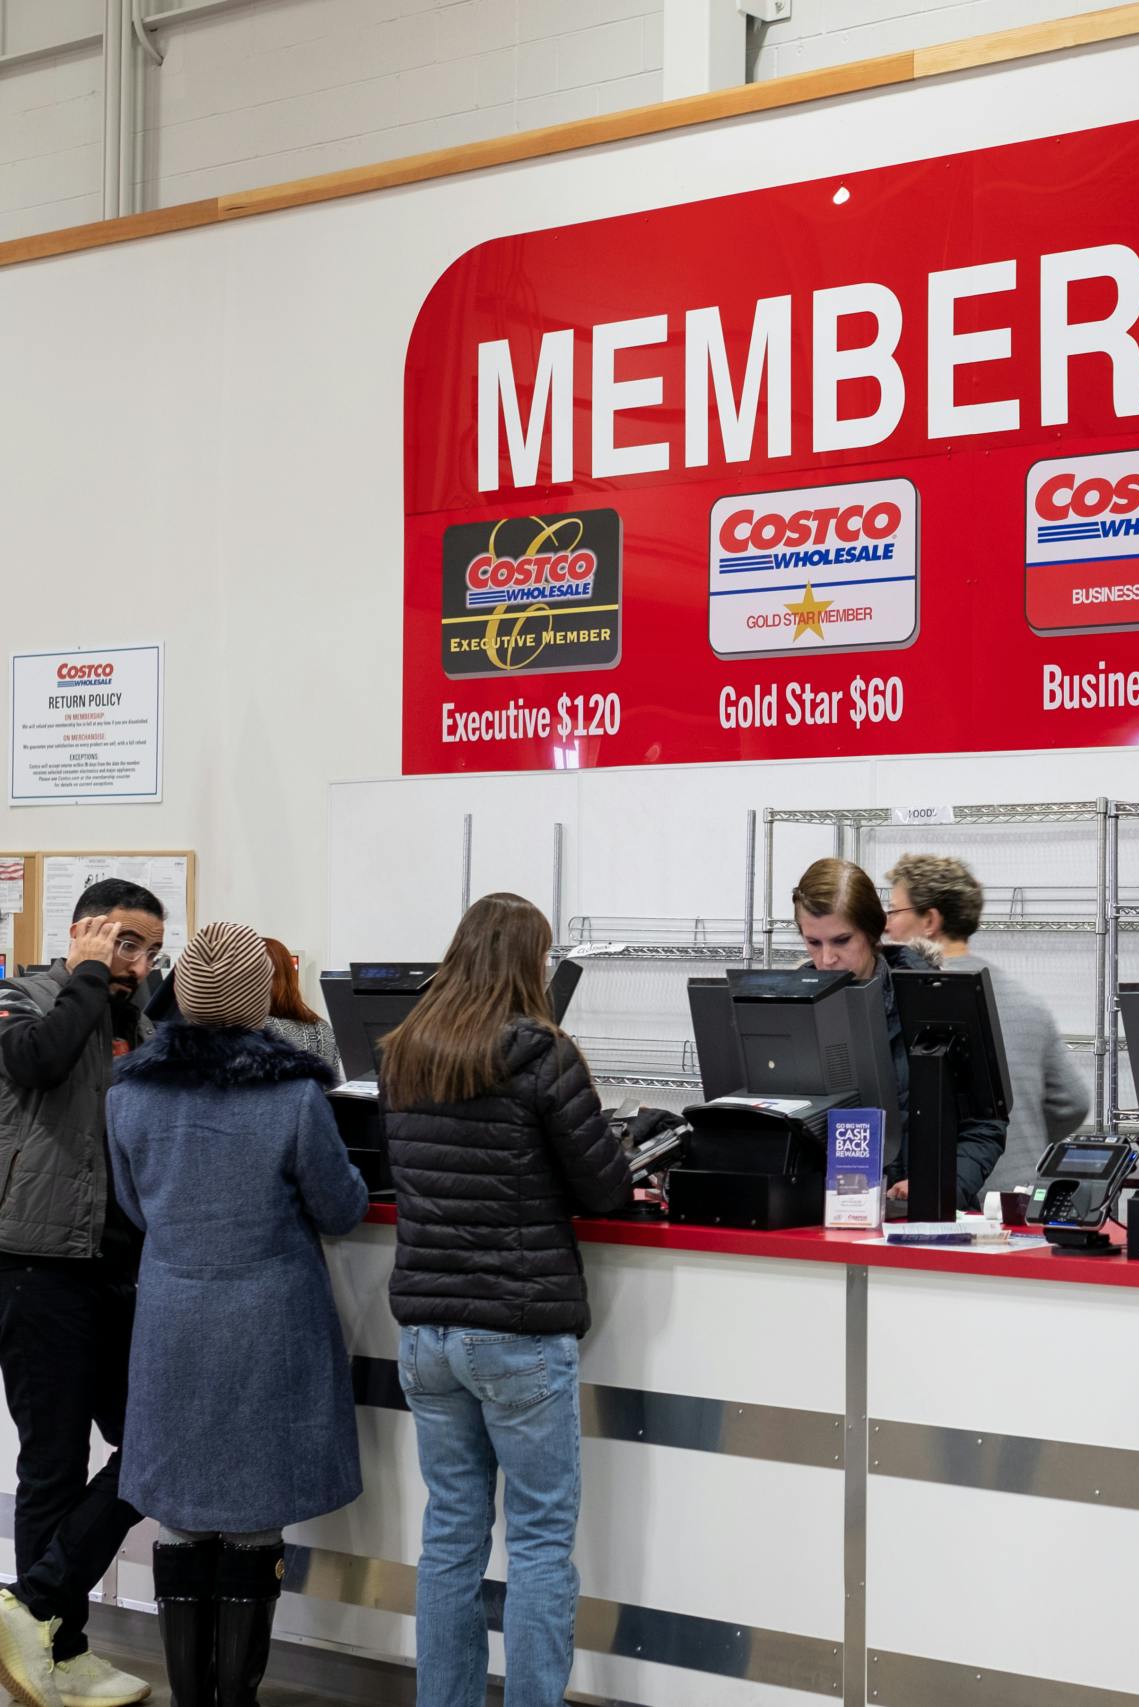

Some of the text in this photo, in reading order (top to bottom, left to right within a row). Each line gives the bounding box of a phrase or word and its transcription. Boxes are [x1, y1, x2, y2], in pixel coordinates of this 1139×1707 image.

[719, 501, 902, 554] COSTCO
[773, 543, 895, 569] WHOLESALE
[467, 552, 595, 590] COSTCO
[505, 582, 591, 602] WHOLESALE
[747, 607, 873, 629] GOLD STAR MEMBER
[451, 628, 610, 652] EXECUTIVE MEMBER
[57, 662, 114, 680] COSTCO
[74, 678, 112, 686] WHOLESALE
[48, 692, 122, 709] RETURN POLICY
[719, 674, 903, 729] Gold Star $60
[442, 692, 621, 742] Executive $120
[836, 1129, 870, 1140] CASH
[836, 1140, 870, 1151] BACK
[836, 1150, 870, 1158] REWARDS
